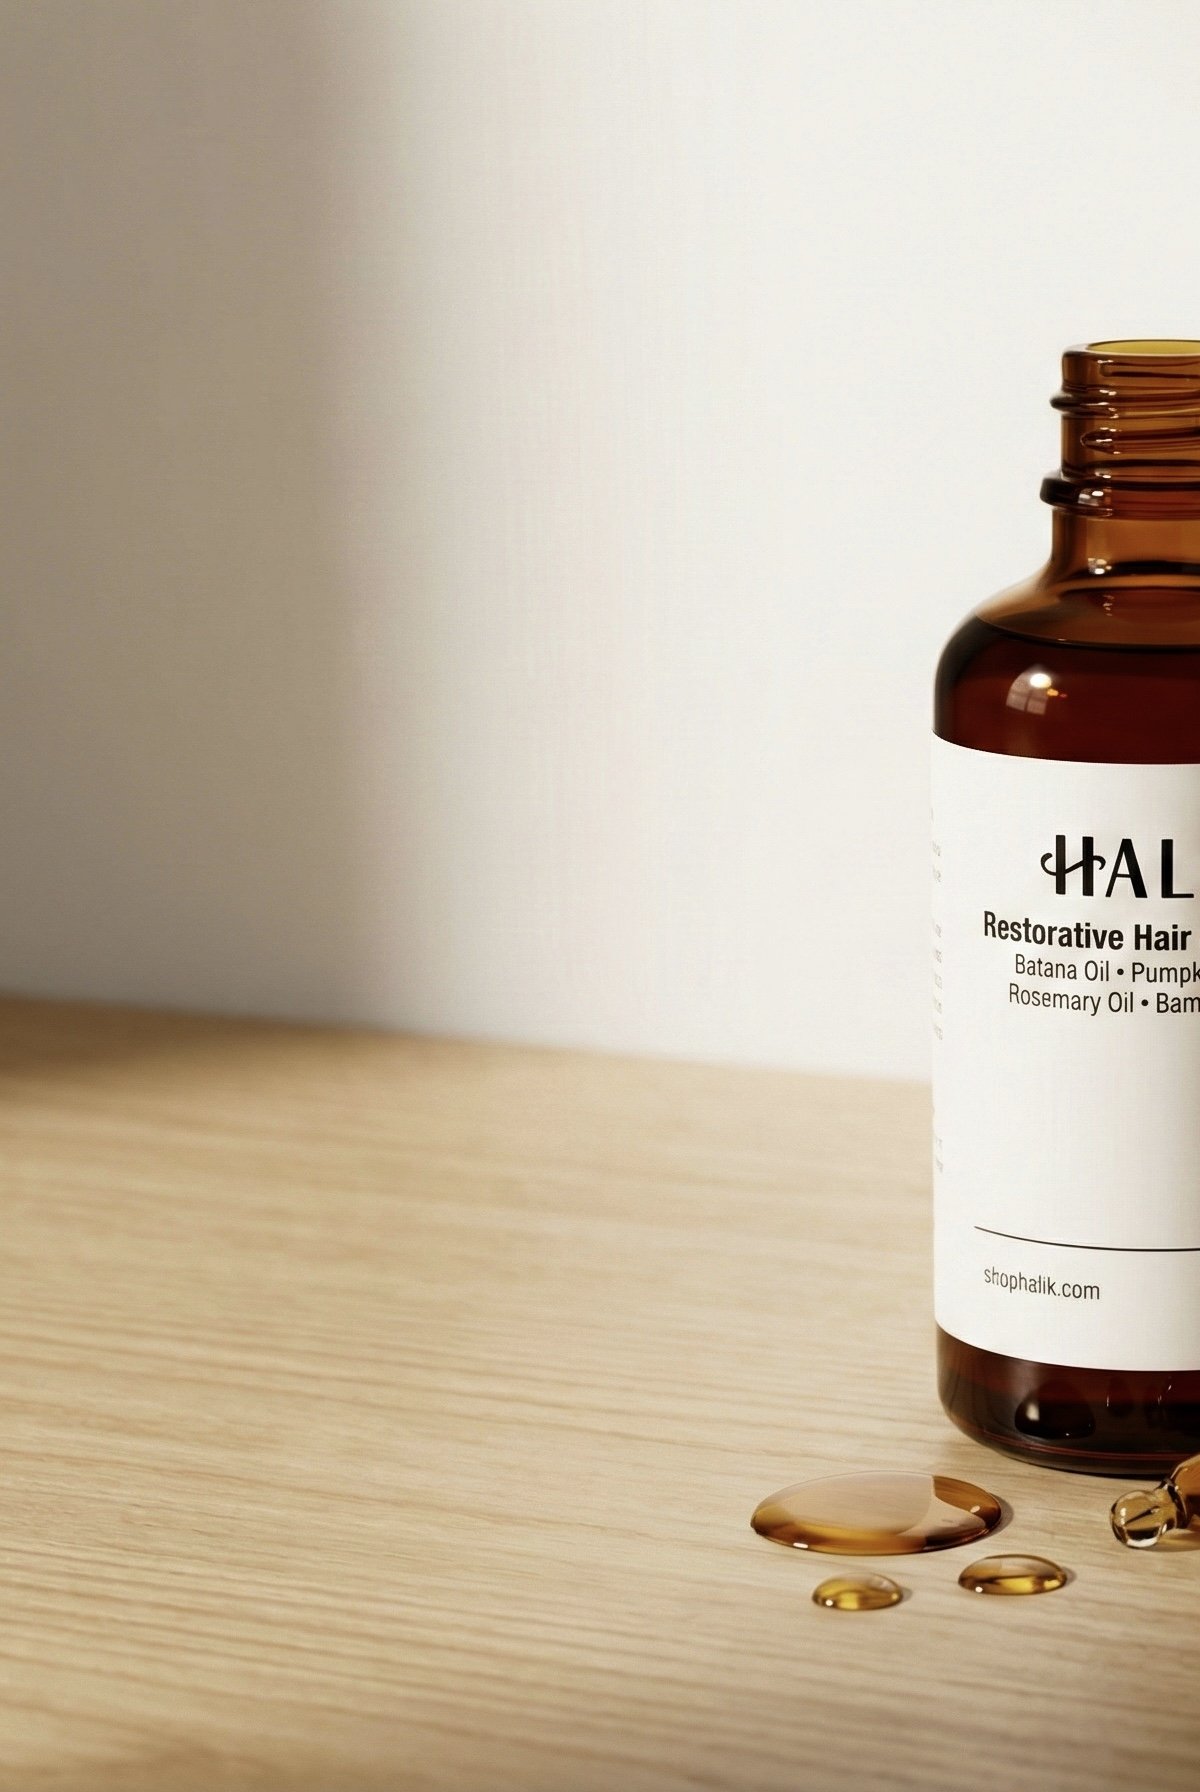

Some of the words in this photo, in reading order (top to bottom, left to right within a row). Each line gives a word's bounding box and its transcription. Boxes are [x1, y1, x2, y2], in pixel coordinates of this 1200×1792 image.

[983, 910, 1124, 951] Restorative
[1134, 923, 1193, 952] Hair
[1015, 953, 1078, 981] Batana
[1084, 959, 1110, 982] Oil
[1009, 982, 1102, 1017] Rosemary
[1107, 991, 1134, 1014] Oil
[983, 1266, 1100, 1300] shophalik.com
